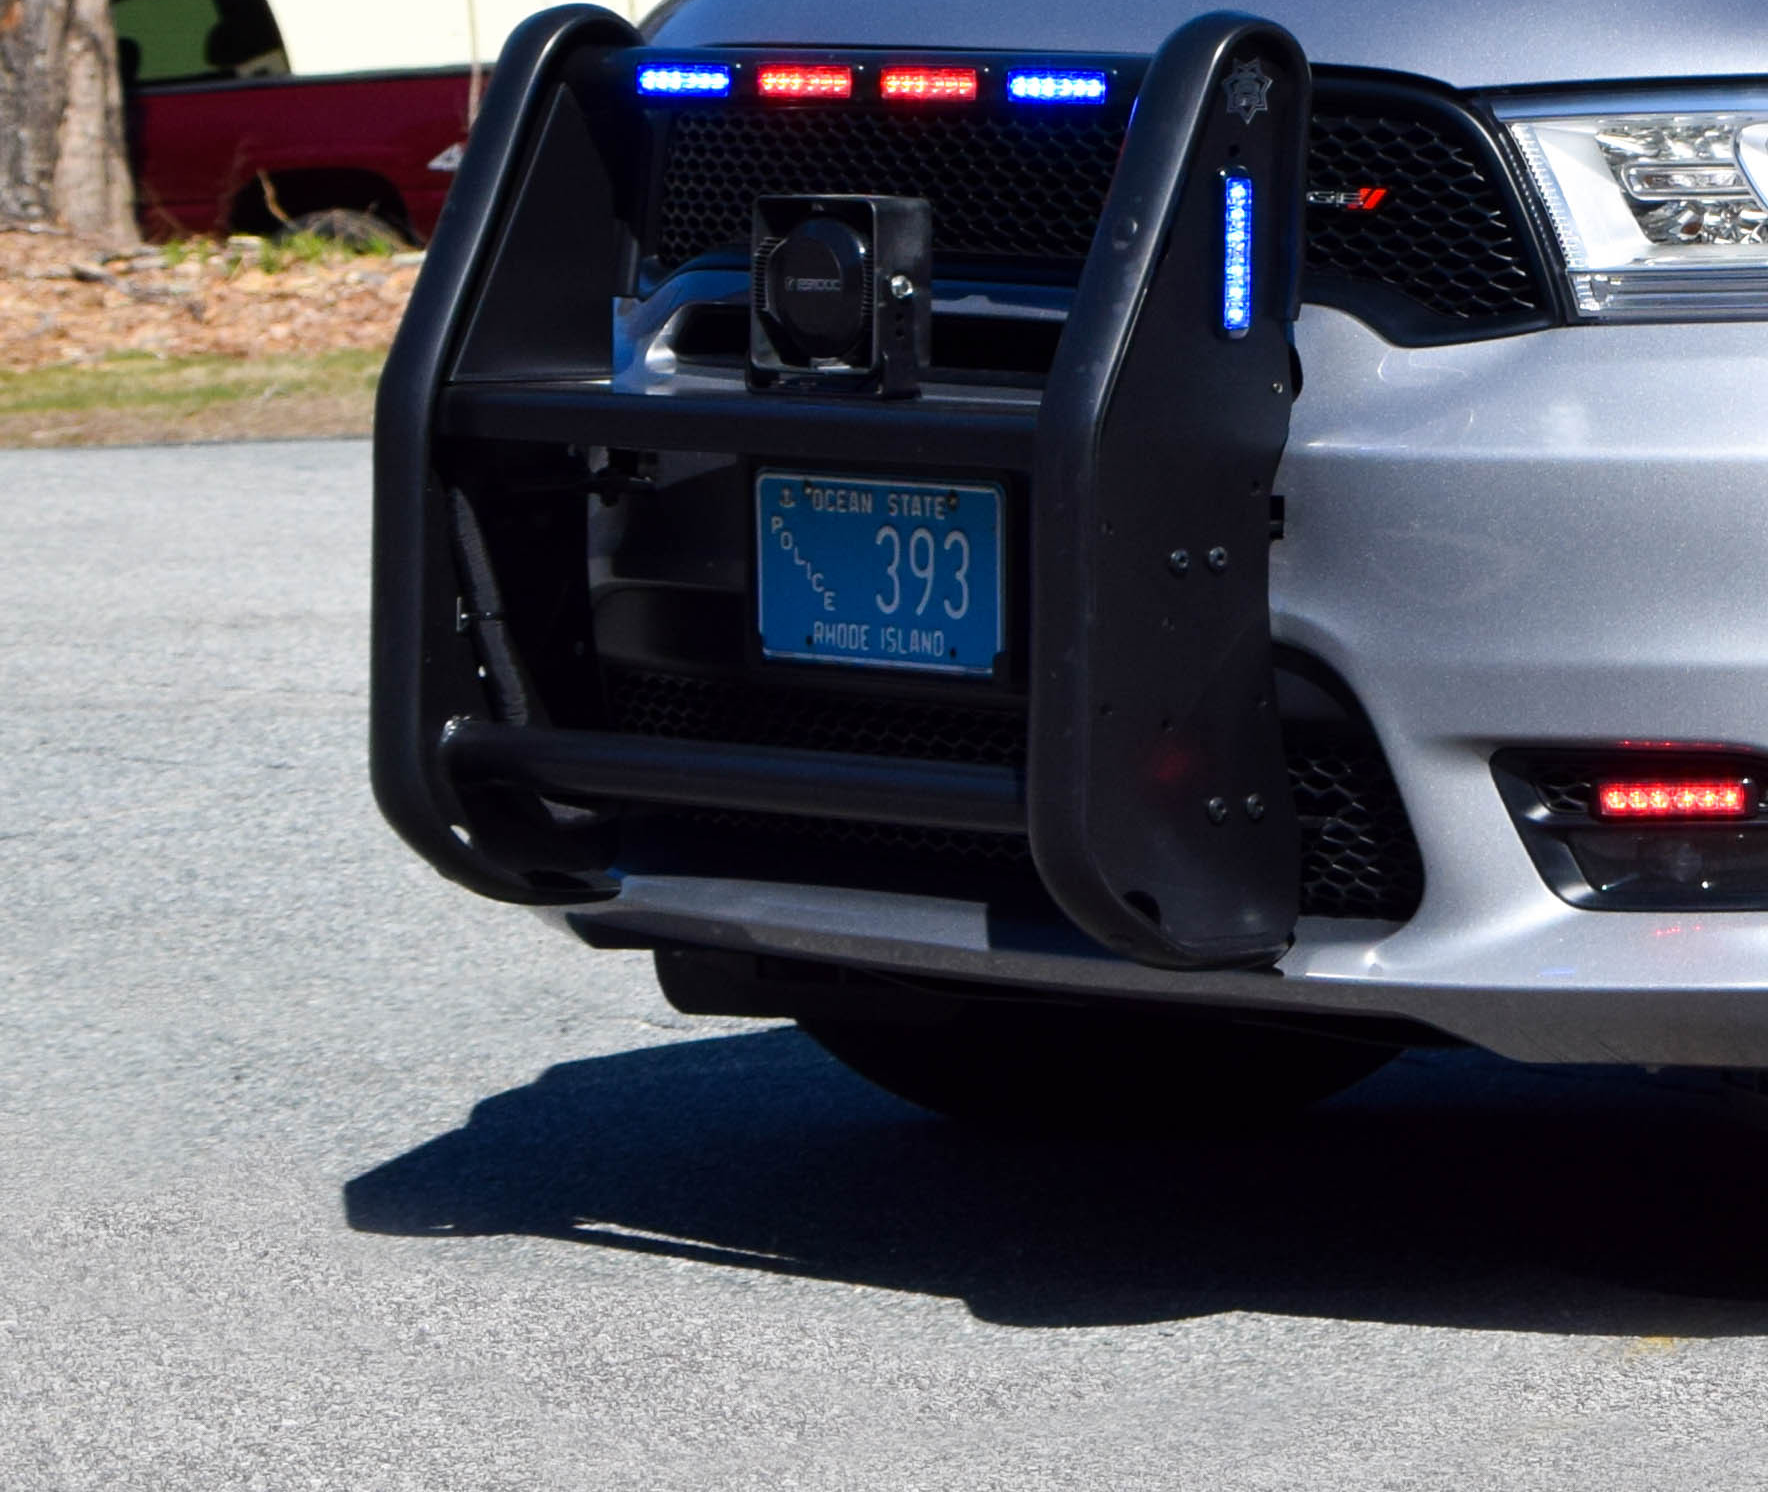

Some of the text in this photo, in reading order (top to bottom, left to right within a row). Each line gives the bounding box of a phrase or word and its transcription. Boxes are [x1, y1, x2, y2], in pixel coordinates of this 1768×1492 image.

[812, 488, 946, 521] OCEAN STATE
[770, 515, 837, 612] POLICE
[875, 525, 970, 620] 393
[813, 621, 945, 657] RHODE ISLAND
